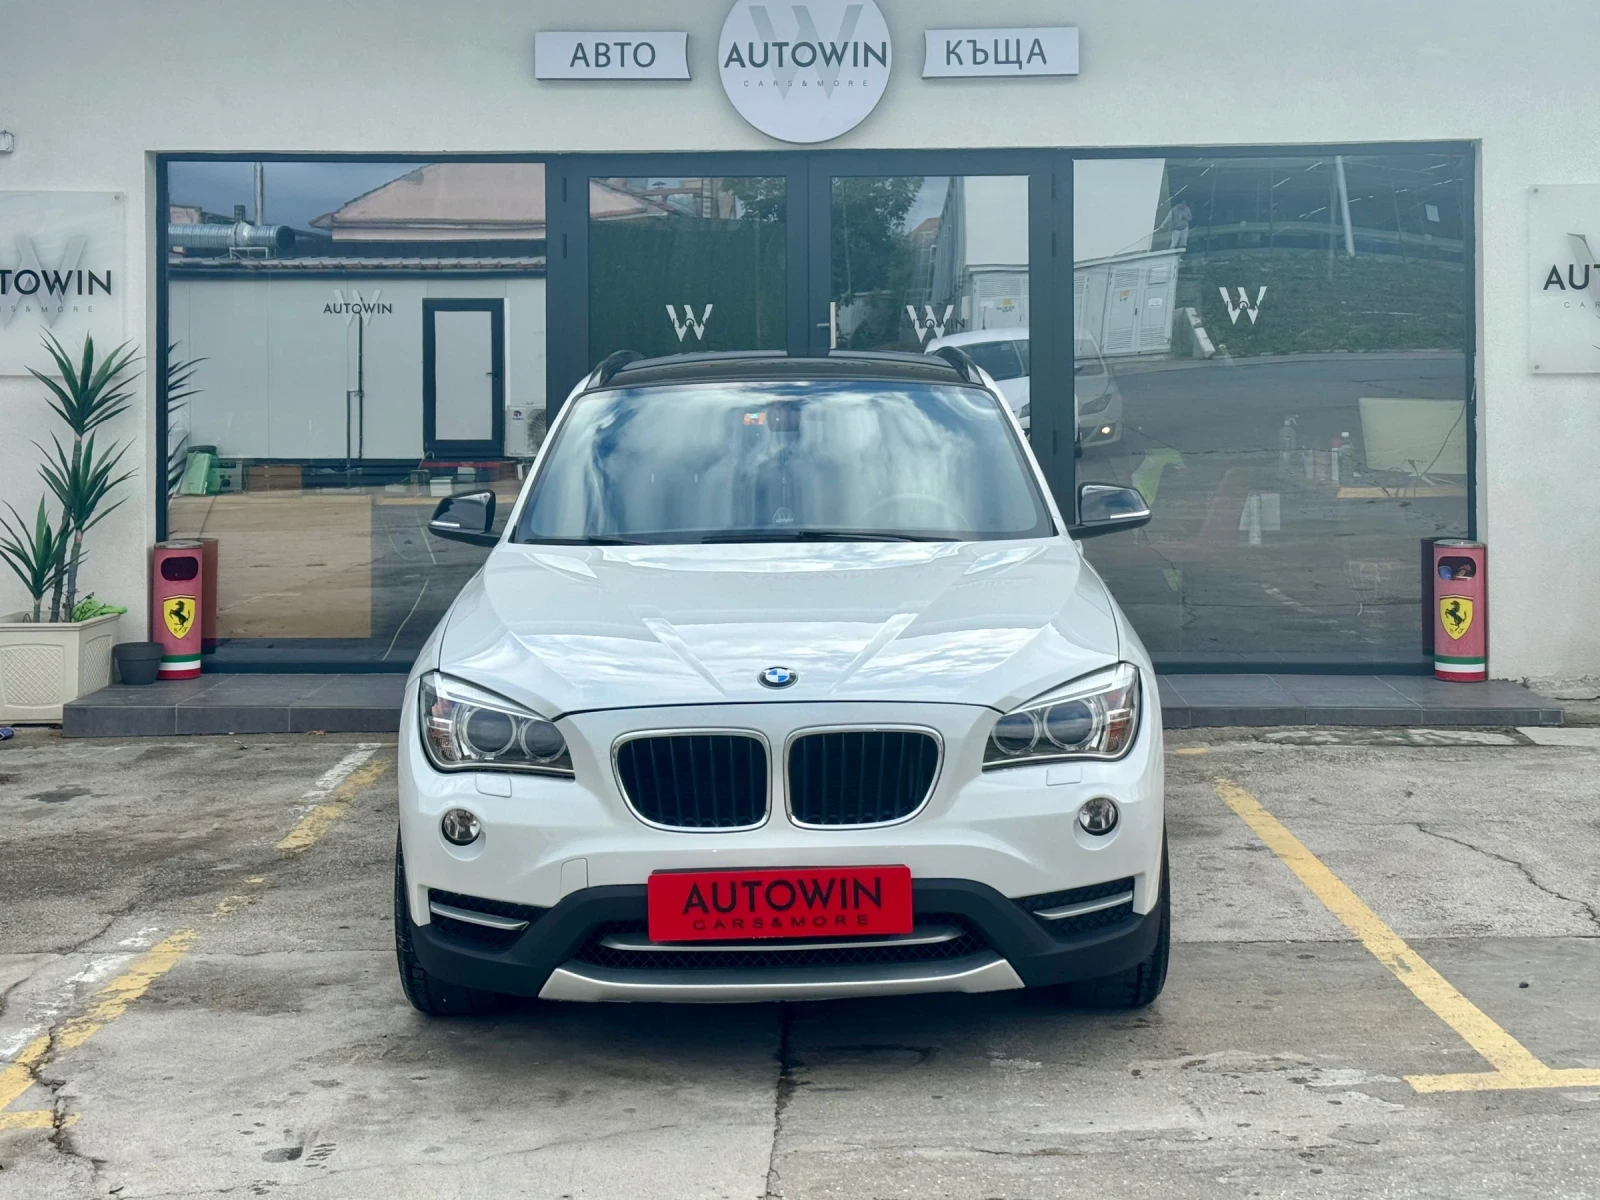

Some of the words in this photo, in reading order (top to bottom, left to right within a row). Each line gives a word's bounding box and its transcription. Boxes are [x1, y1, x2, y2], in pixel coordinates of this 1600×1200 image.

[570, 42, 656, 67] АВТО
[723, 41, 887, 68] AUTOWIN
[946, 38, 1047, 70] КЪЩА
[323, 303, 392, 314] AUTOWIN
[682, 876, 881, 915] AUTOWIN
[693, 914, 869, 931] CARS&MORE
